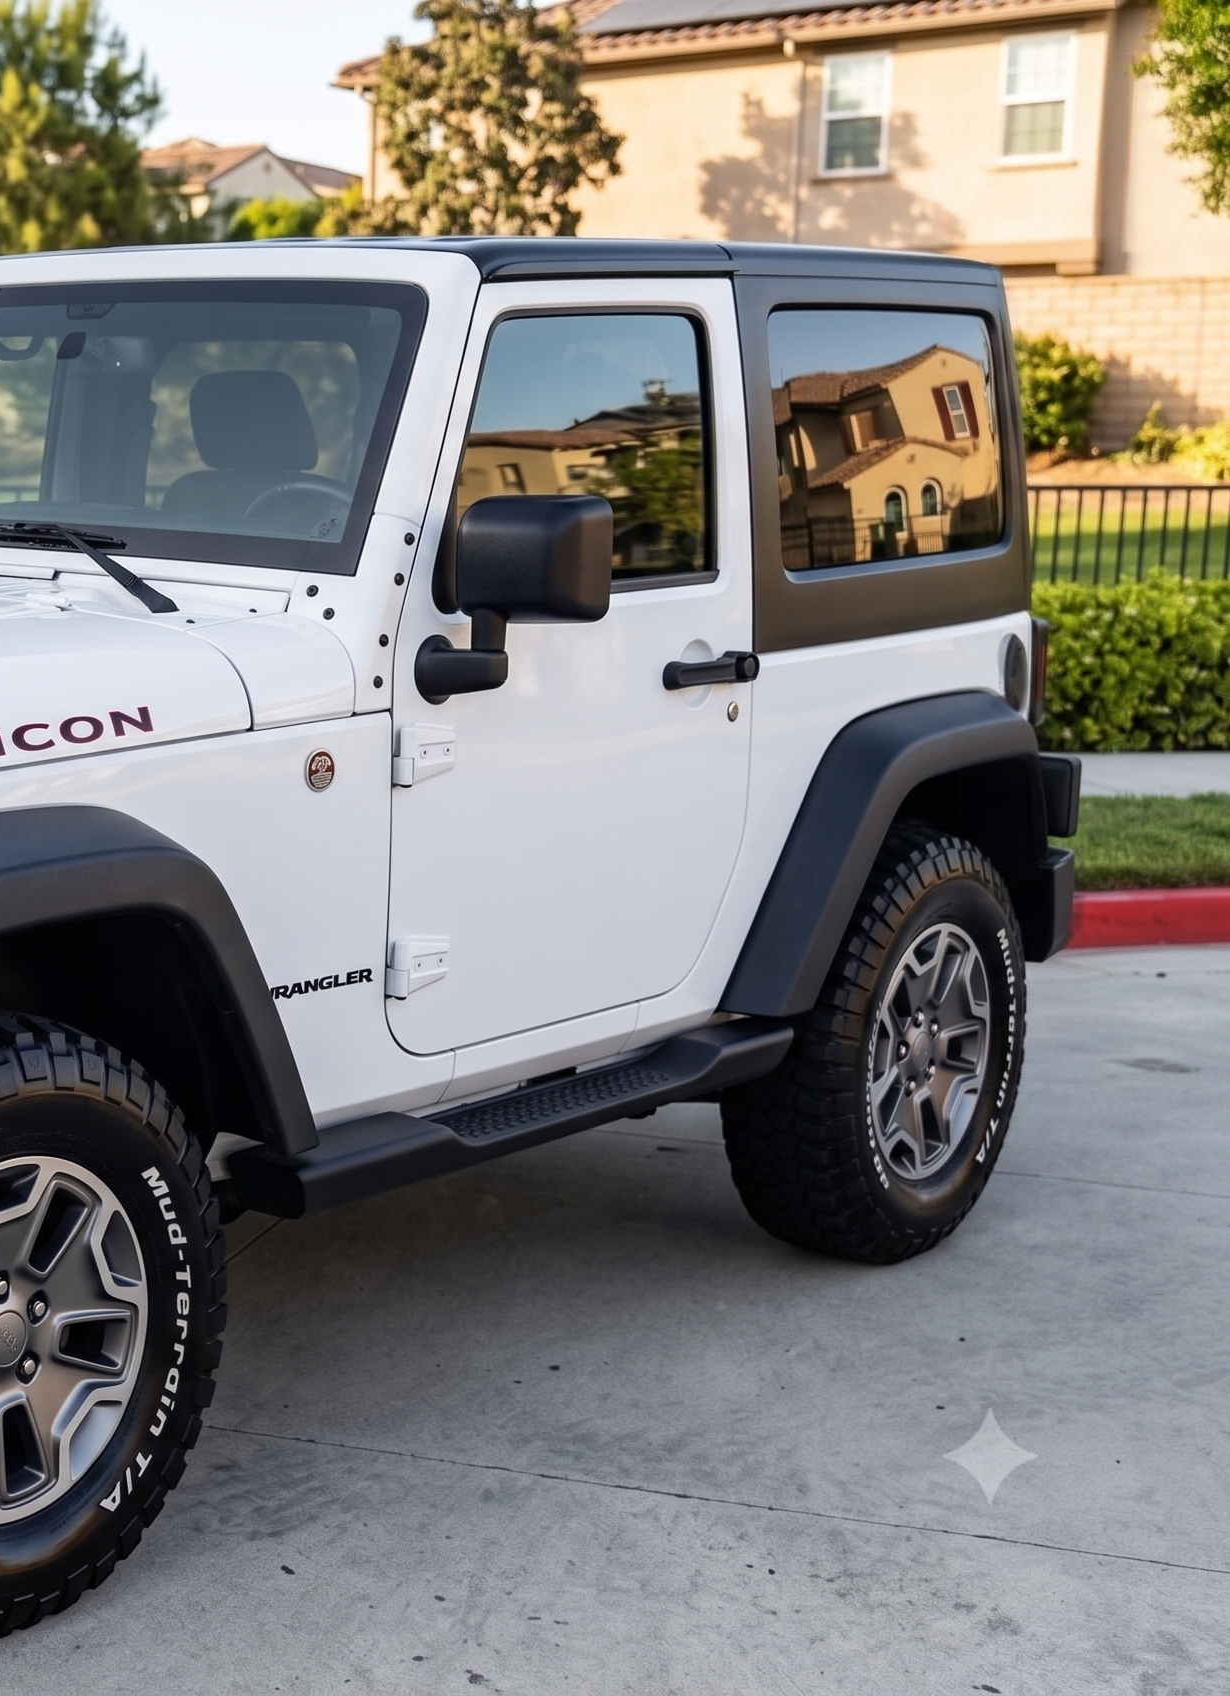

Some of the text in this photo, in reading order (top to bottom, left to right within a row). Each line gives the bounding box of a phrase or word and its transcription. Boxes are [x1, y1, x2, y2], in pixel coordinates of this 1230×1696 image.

[975, 1117, 999, 1164] T/A
[99, 1165, 192, 1513] Mud-Terrain T/A
